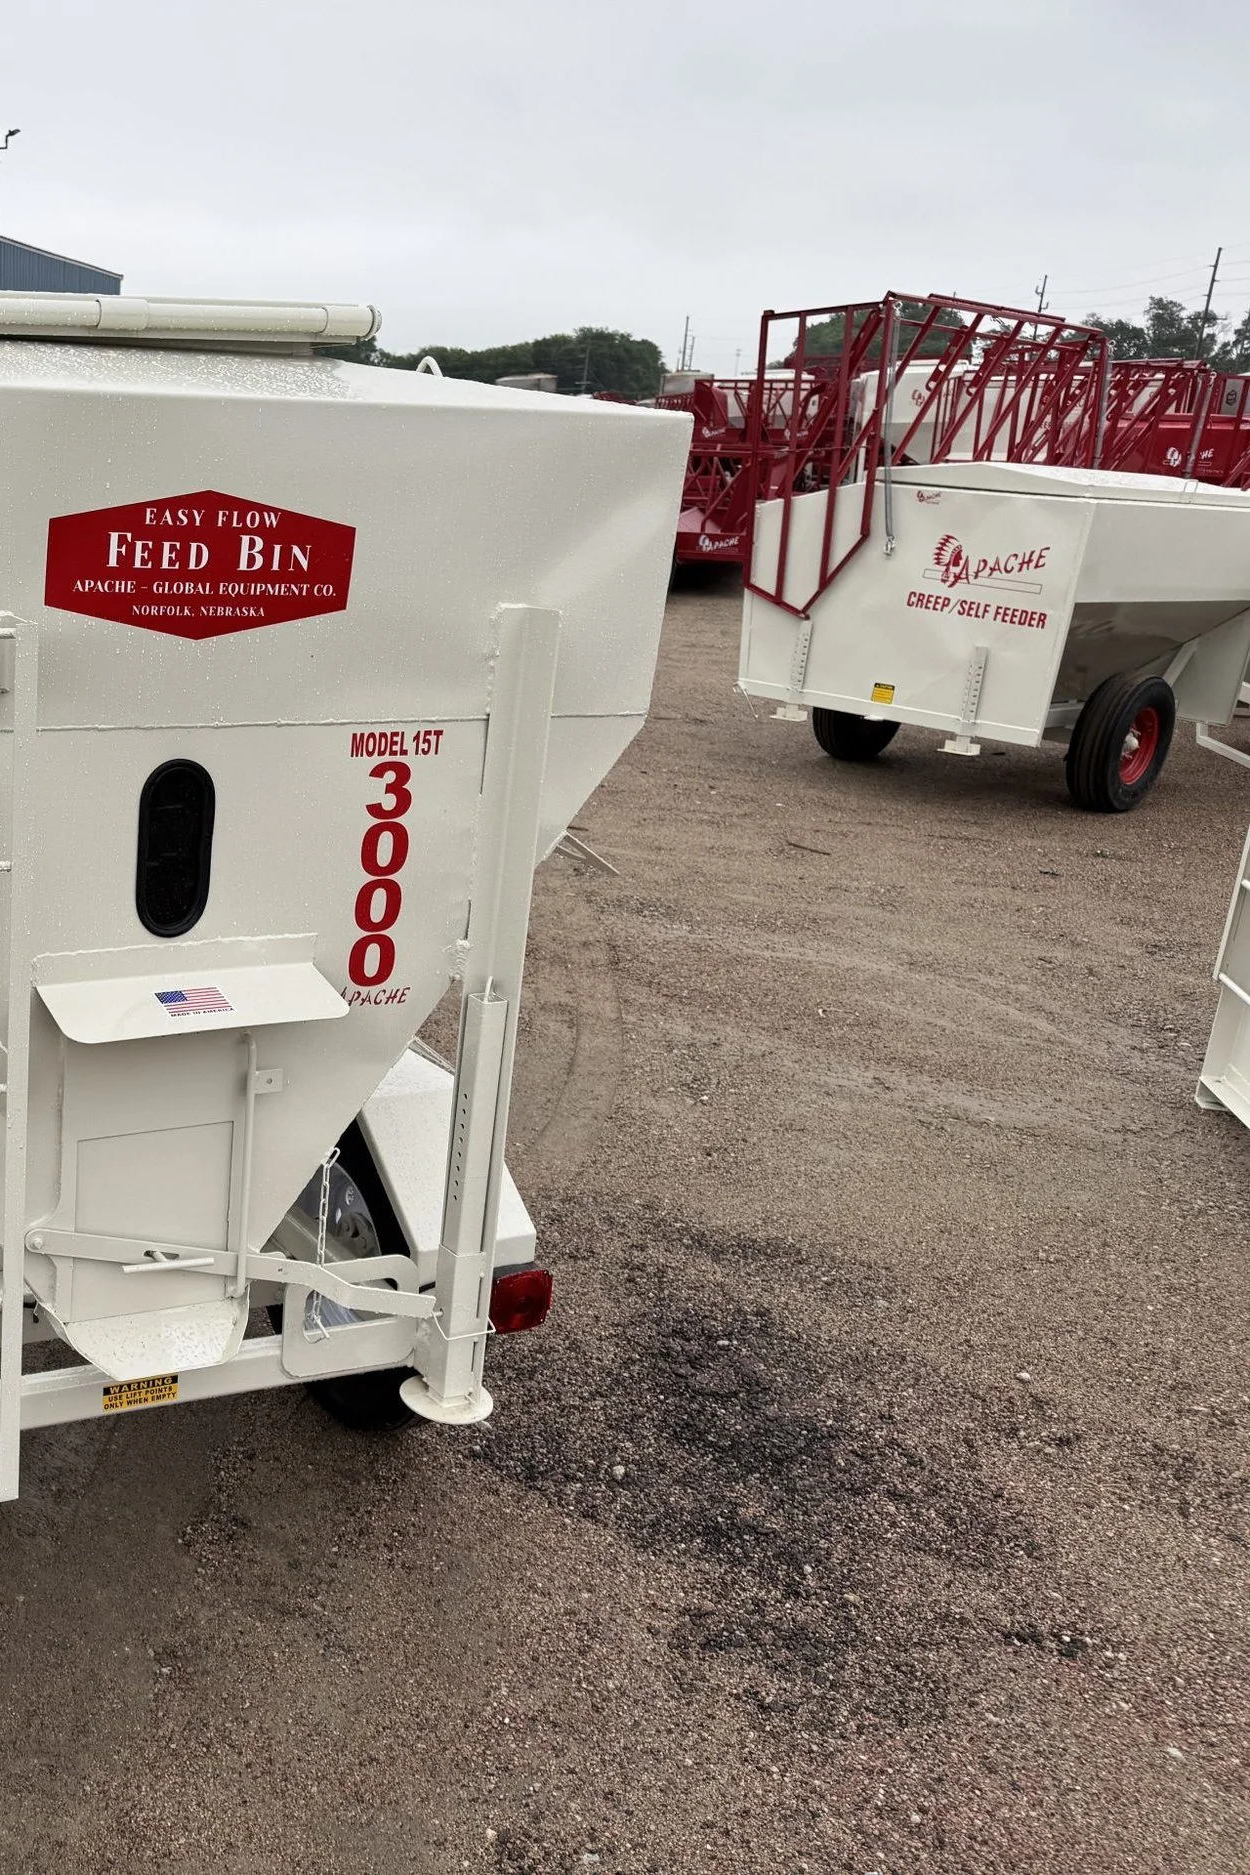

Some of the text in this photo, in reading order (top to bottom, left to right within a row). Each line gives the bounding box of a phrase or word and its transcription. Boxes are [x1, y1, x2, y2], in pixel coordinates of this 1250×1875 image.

[145, 508, 281, 529] EASY FLOW
[106, 531, 312, 572] FEED BIN
[948, 546, 1050, 588] APACHE
[73, 579, 136, 594] APACHE
[153, 581, 213, 595] GLOBAL
[218, 582, 310, 598] EQUIPMENT
[313, 583, 336, 597] CO.
[132, 604, 265, 617] NORFOLK, NEBRASKA
[906, 591, 1048, 629] CREEP/SELF FEEDER
[350, 731, 409, 757] MODEL
[348, 761, 413, 987] 3000
[108, 1386, 173, 1402] USE LIFT POINTS
[110, 1377, 172, 1394] WARNING
[103, 1391, 177, 1410] ONLY WHEN EMPTY
